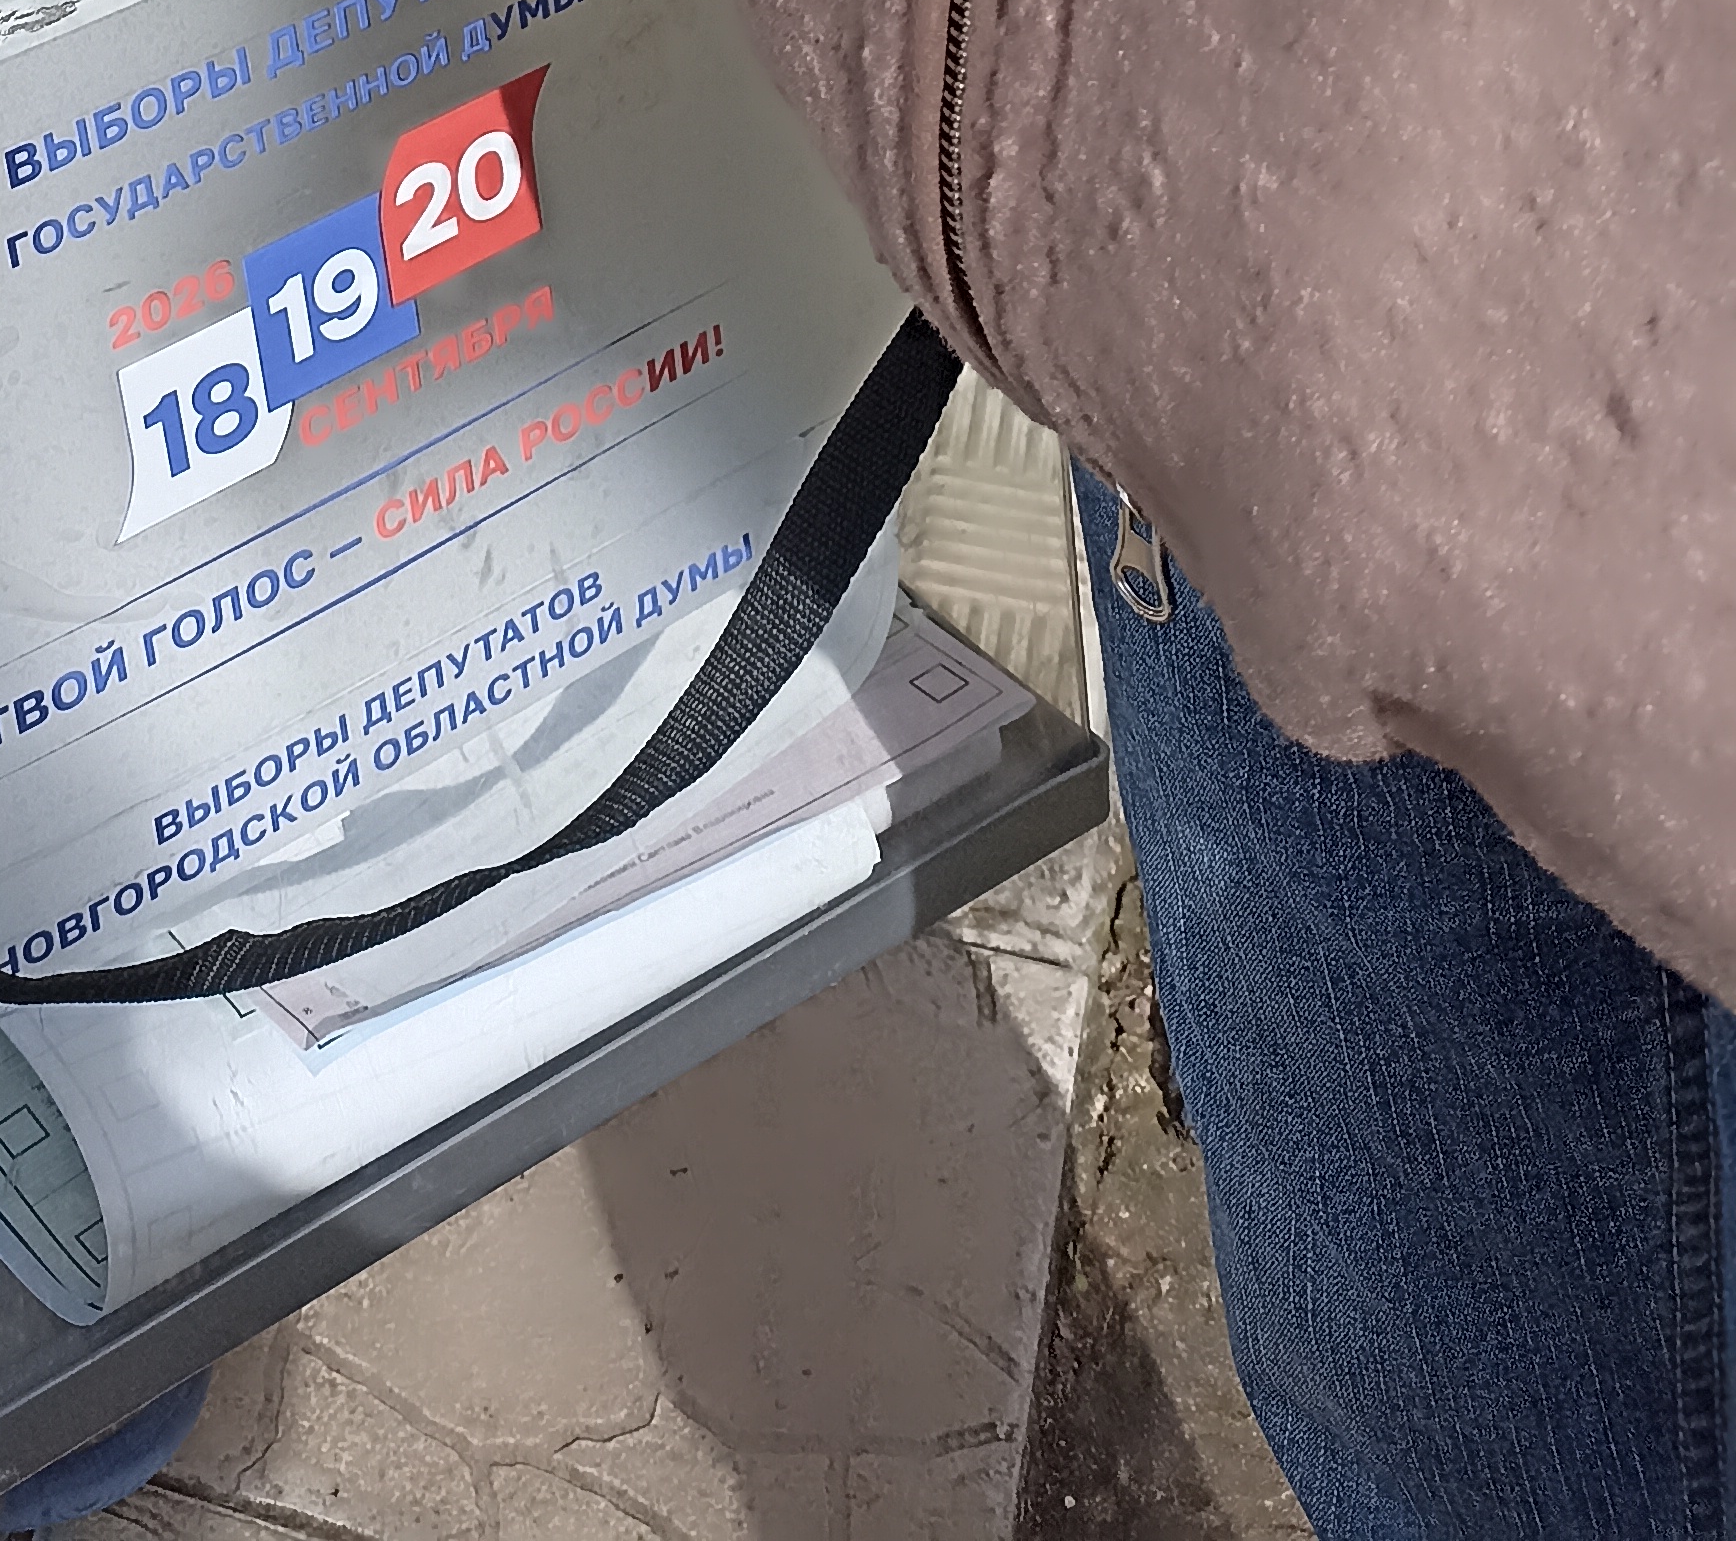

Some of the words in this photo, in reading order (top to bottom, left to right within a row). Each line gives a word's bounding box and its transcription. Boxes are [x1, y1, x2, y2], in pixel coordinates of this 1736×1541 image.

[3, 48, 254, 190] ВЫБОРЫ
[6, 30, 452, 269] ГОСУДАРСТВЕННОЙ
[107, 259, 236, 351] 2026
[143, 363, 259, 478] 18
[268, 247, 379, 365] 19
[393, 130, 523, 262] 20
[298, 284, 556, 448] СЕНТЯБРЯ
[141, 546, 317, 669] ГОЛОС
[374, 443, 510, 540] СИЛА
[519, 324, 729, 464] РОССИИ!
[154, 707, 350, 846] ВЫБОРЫ
[361, 570, 606, 734] ДЕПУТАТОВ
[371, 604, 625, 772] ОБЛАСТНОЙ
[633, 532, 756, 630] ДУМЫ
